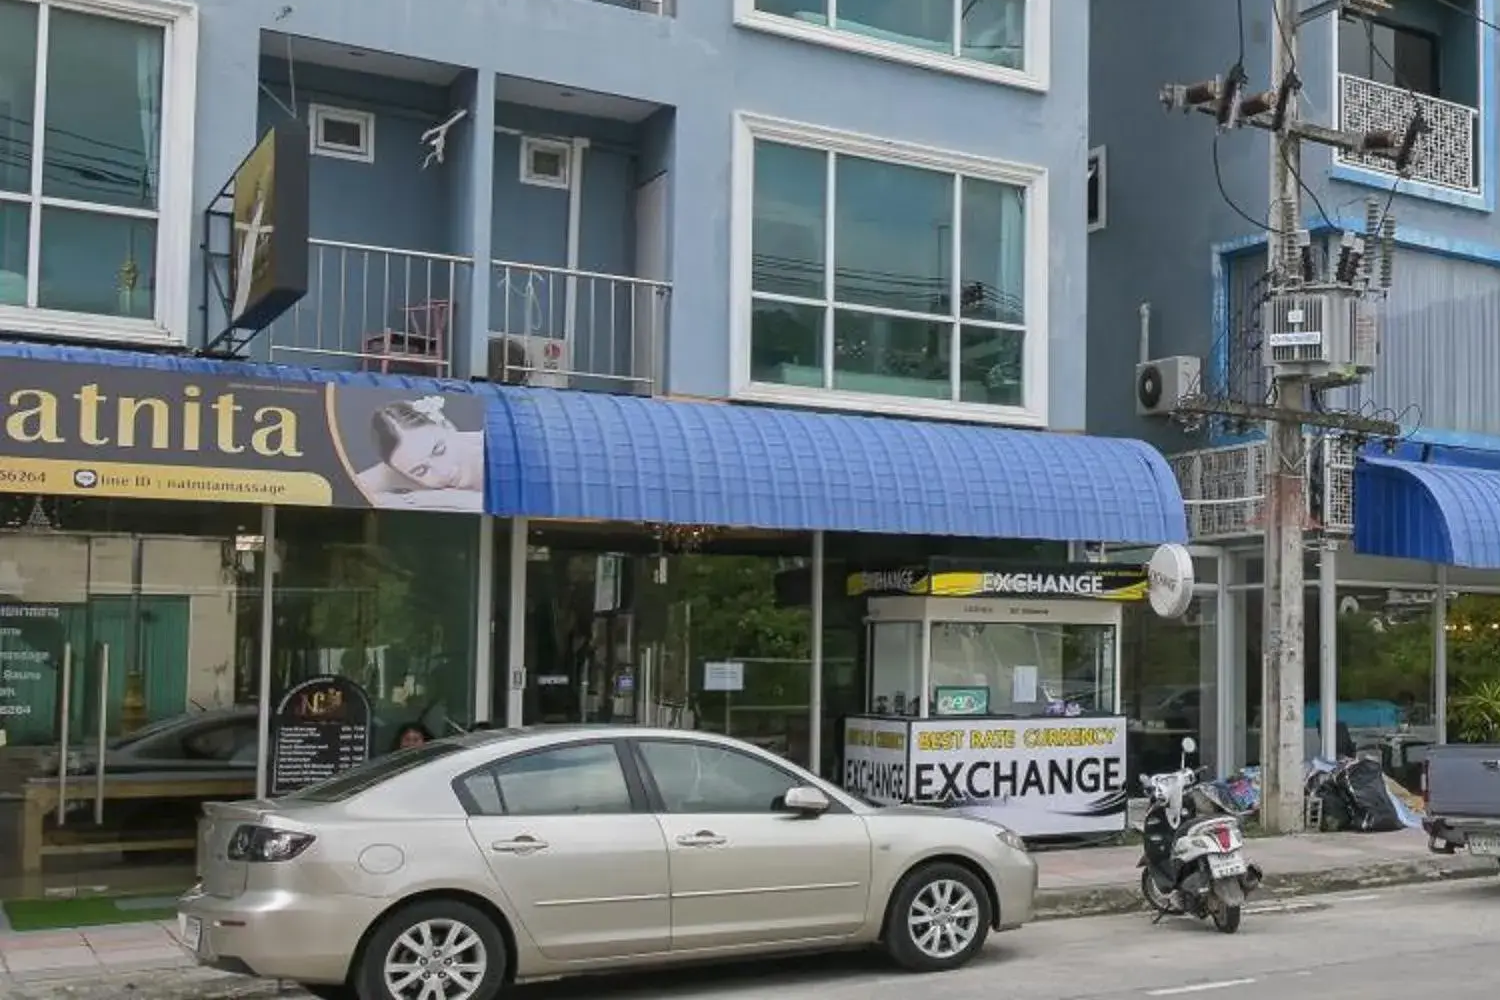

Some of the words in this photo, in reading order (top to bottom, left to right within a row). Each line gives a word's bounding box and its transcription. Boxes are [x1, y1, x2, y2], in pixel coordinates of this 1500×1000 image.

[983, 572, 1103, 593] EXCHANGE
[918, 730, 964, 751] BEST
[970, 729, 1016, 749] RATE
[1023, 727, 1117, 748] CURRENCY
[915, 756, 1121, 801] EXCHANGE
